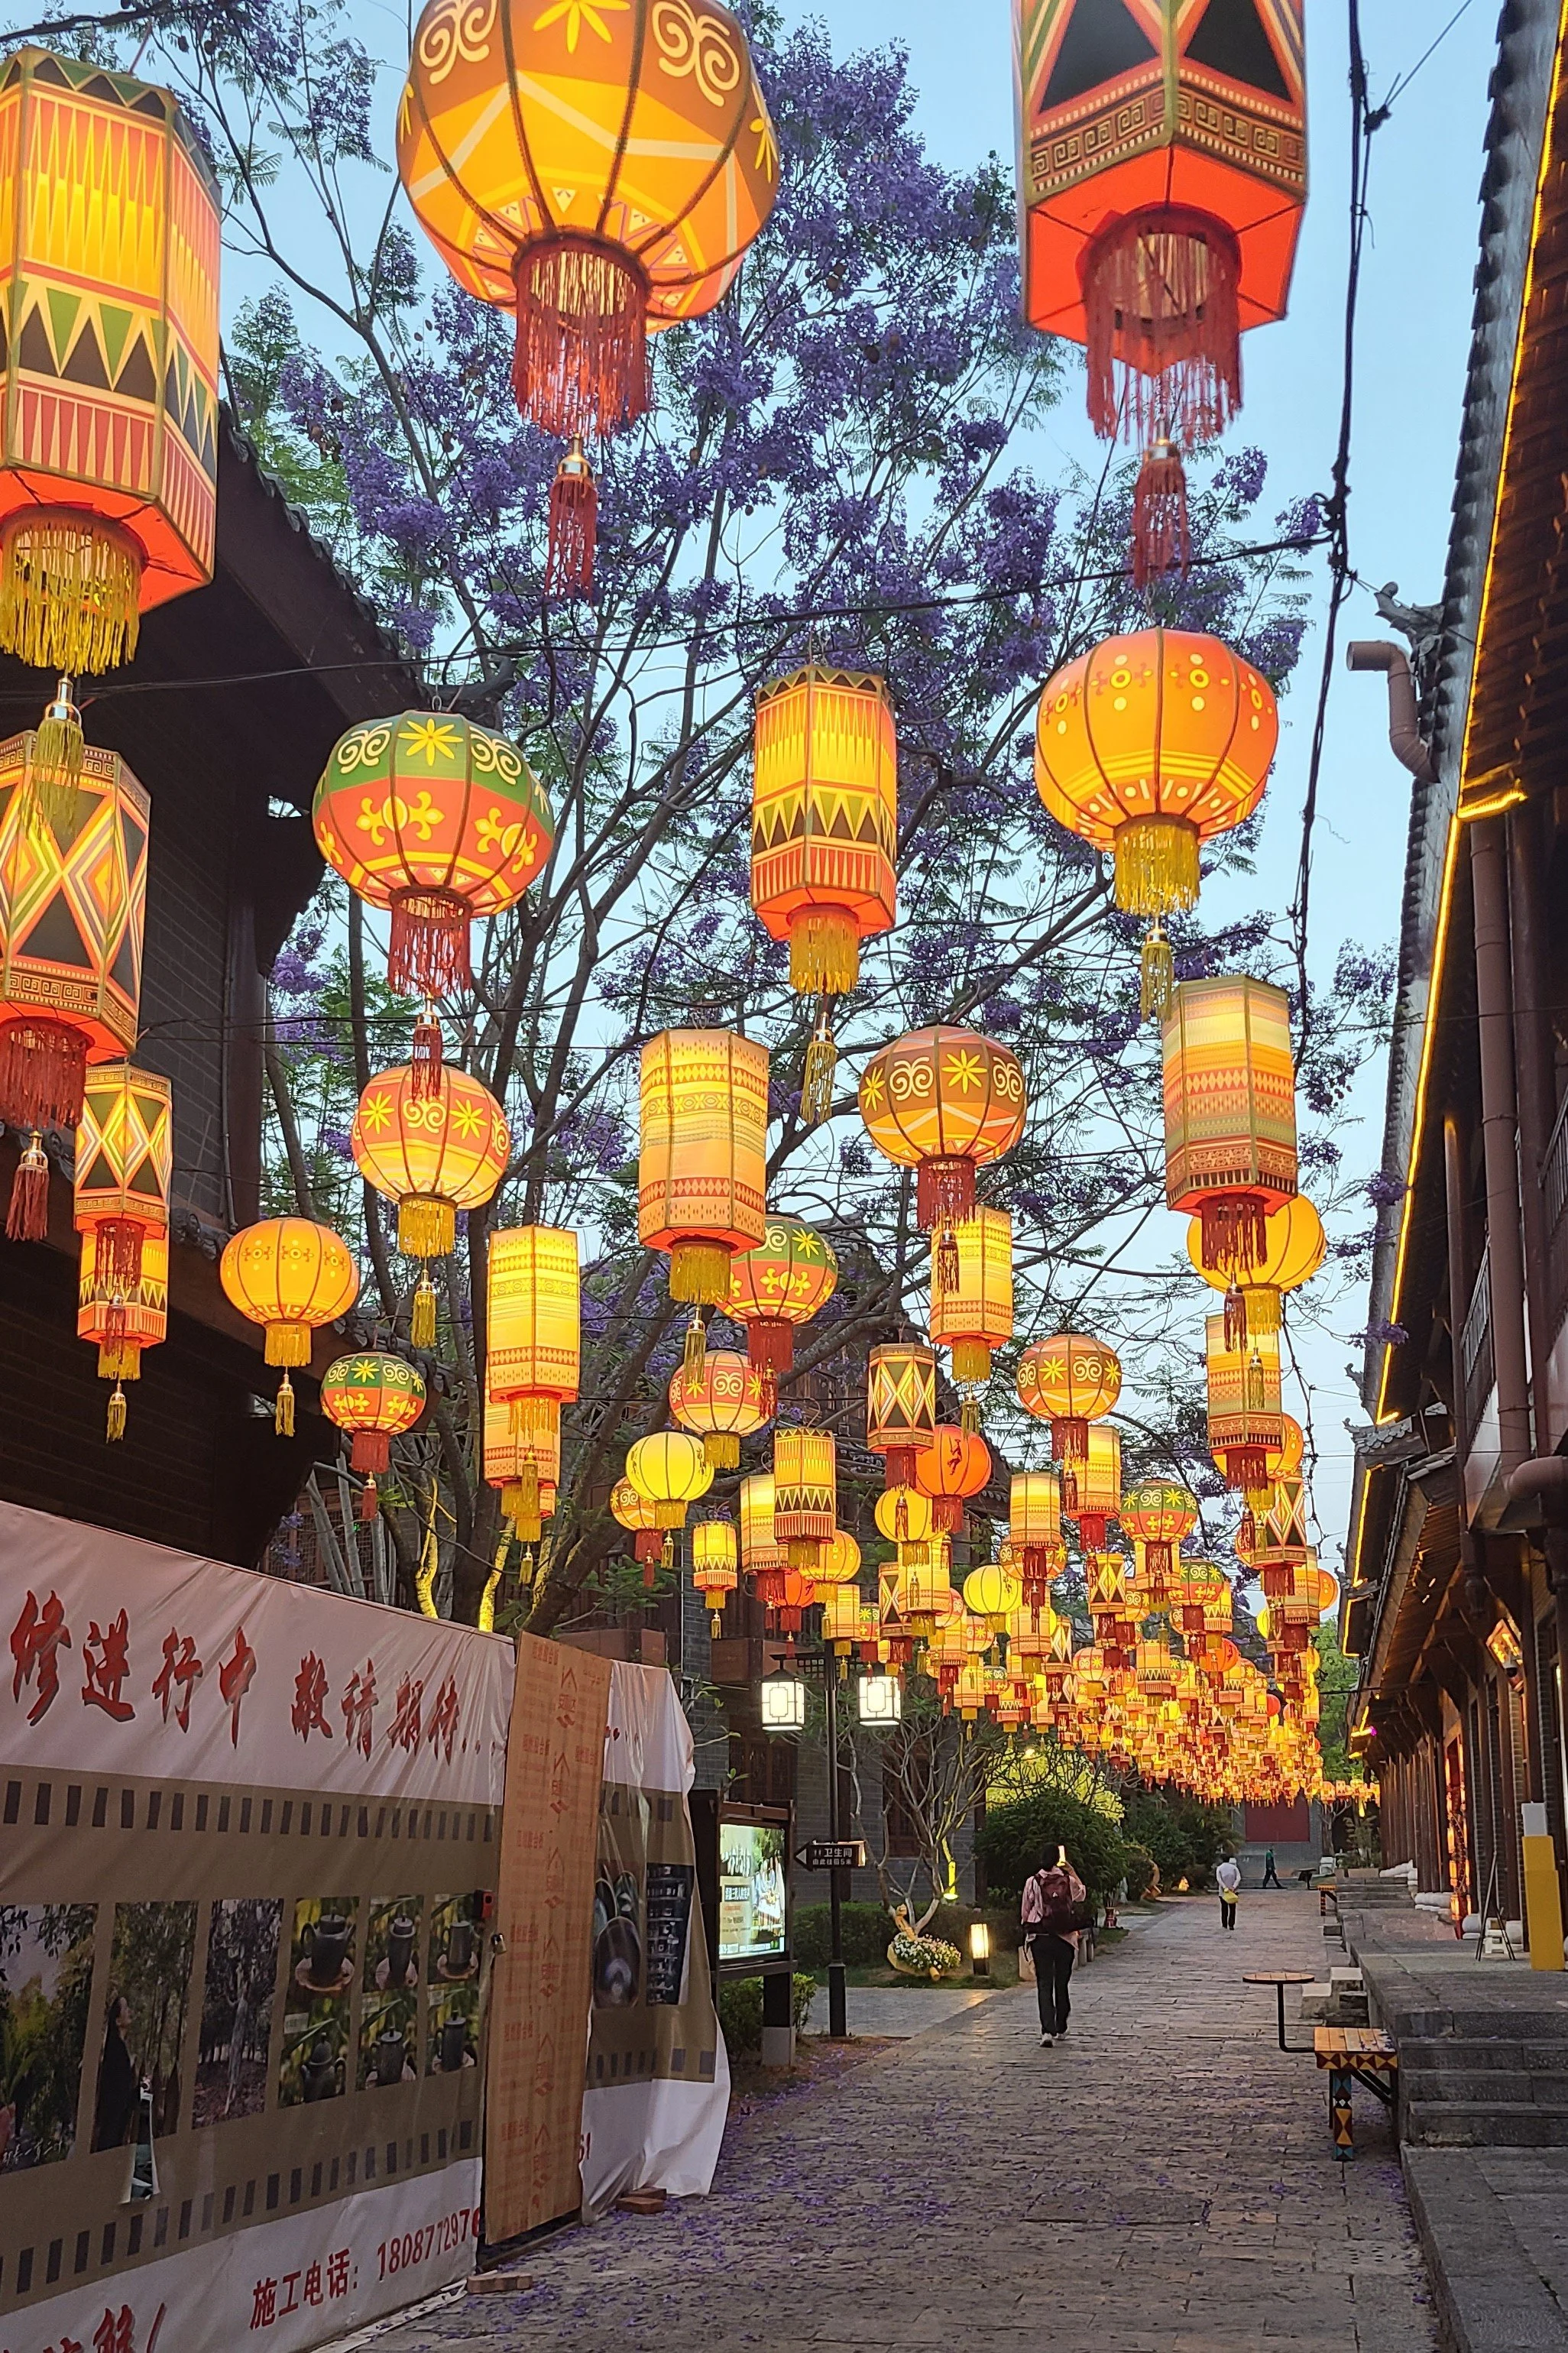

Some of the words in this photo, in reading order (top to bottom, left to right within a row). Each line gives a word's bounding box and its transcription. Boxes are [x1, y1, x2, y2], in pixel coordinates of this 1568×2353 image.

[11, 1590, 258, 1749] 修进行中
[824, 1848, 853, 1858] 卫生间
